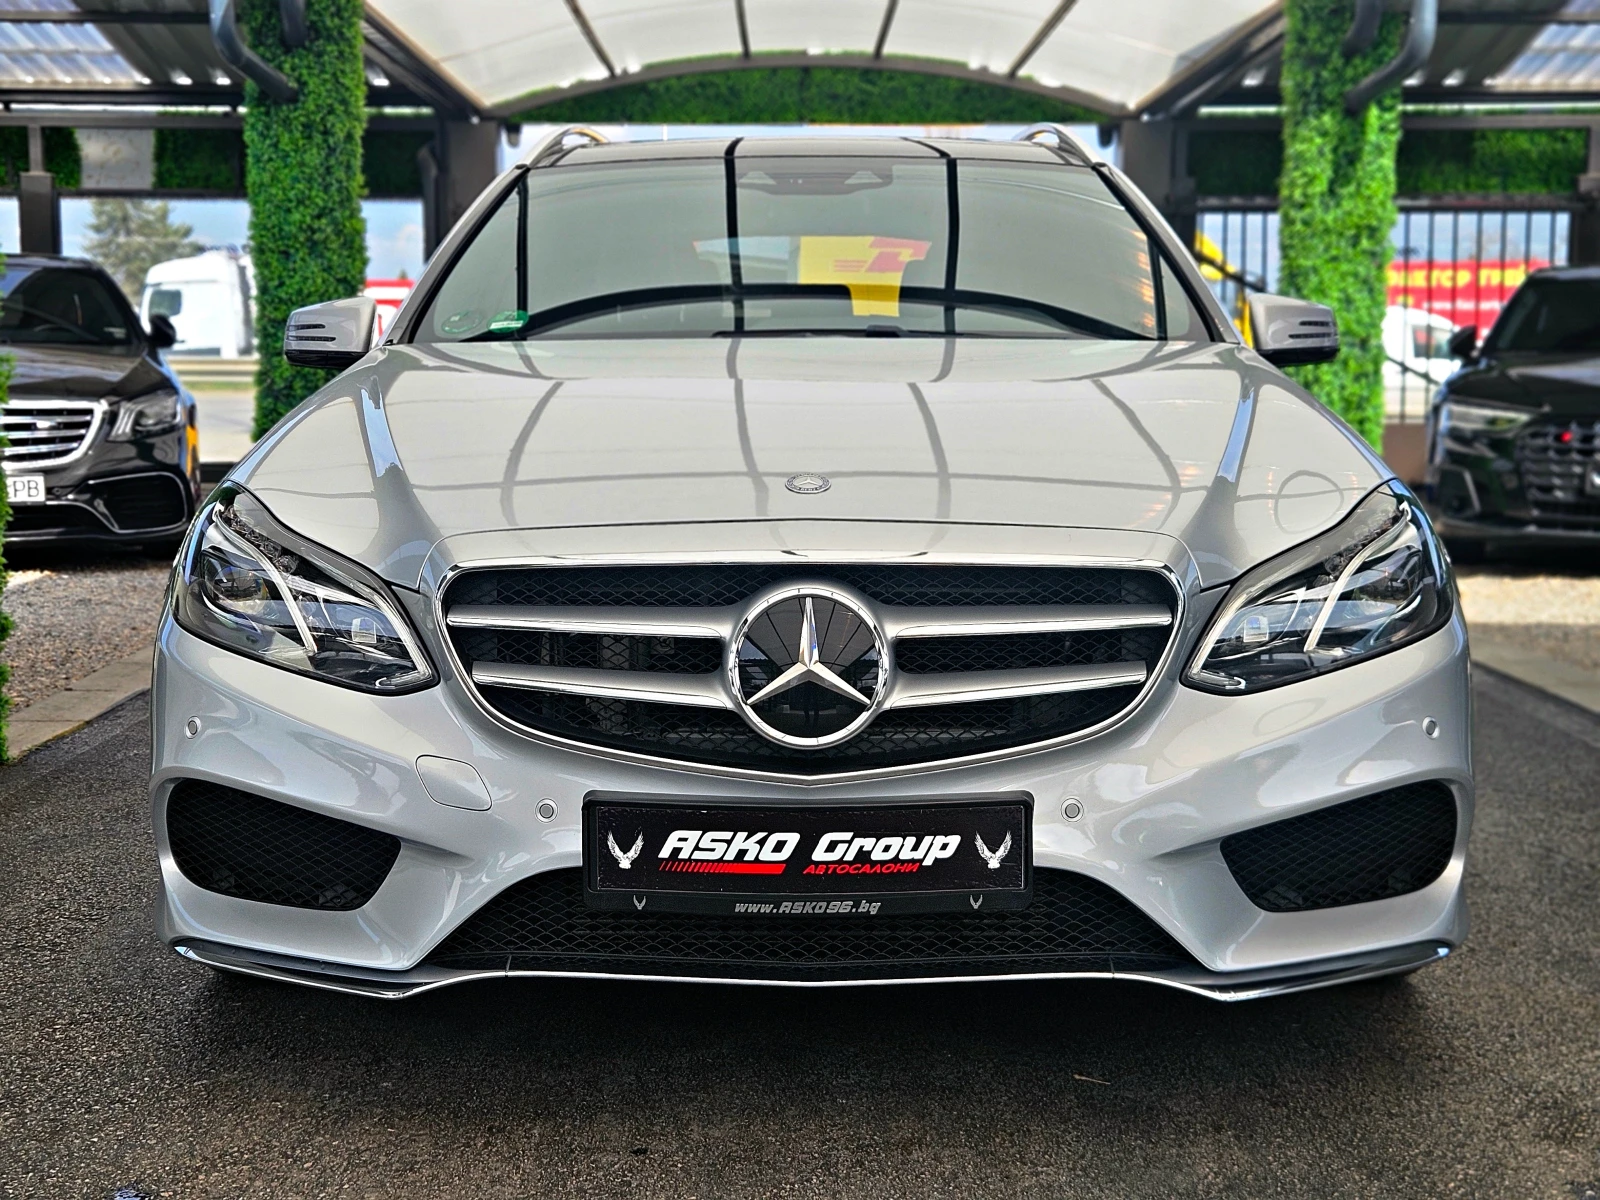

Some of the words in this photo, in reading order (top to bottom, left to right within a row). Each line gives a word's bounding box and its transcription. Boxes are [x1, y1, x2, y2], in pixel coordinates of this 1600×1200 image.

[657, 830, 801, 861] ASKO
[811, 831, 961, 866] Group
[803, 862, 920, 875] АВТОСАЛОНИ
[734, 901, 881, 915] www.ASKO96.bg
